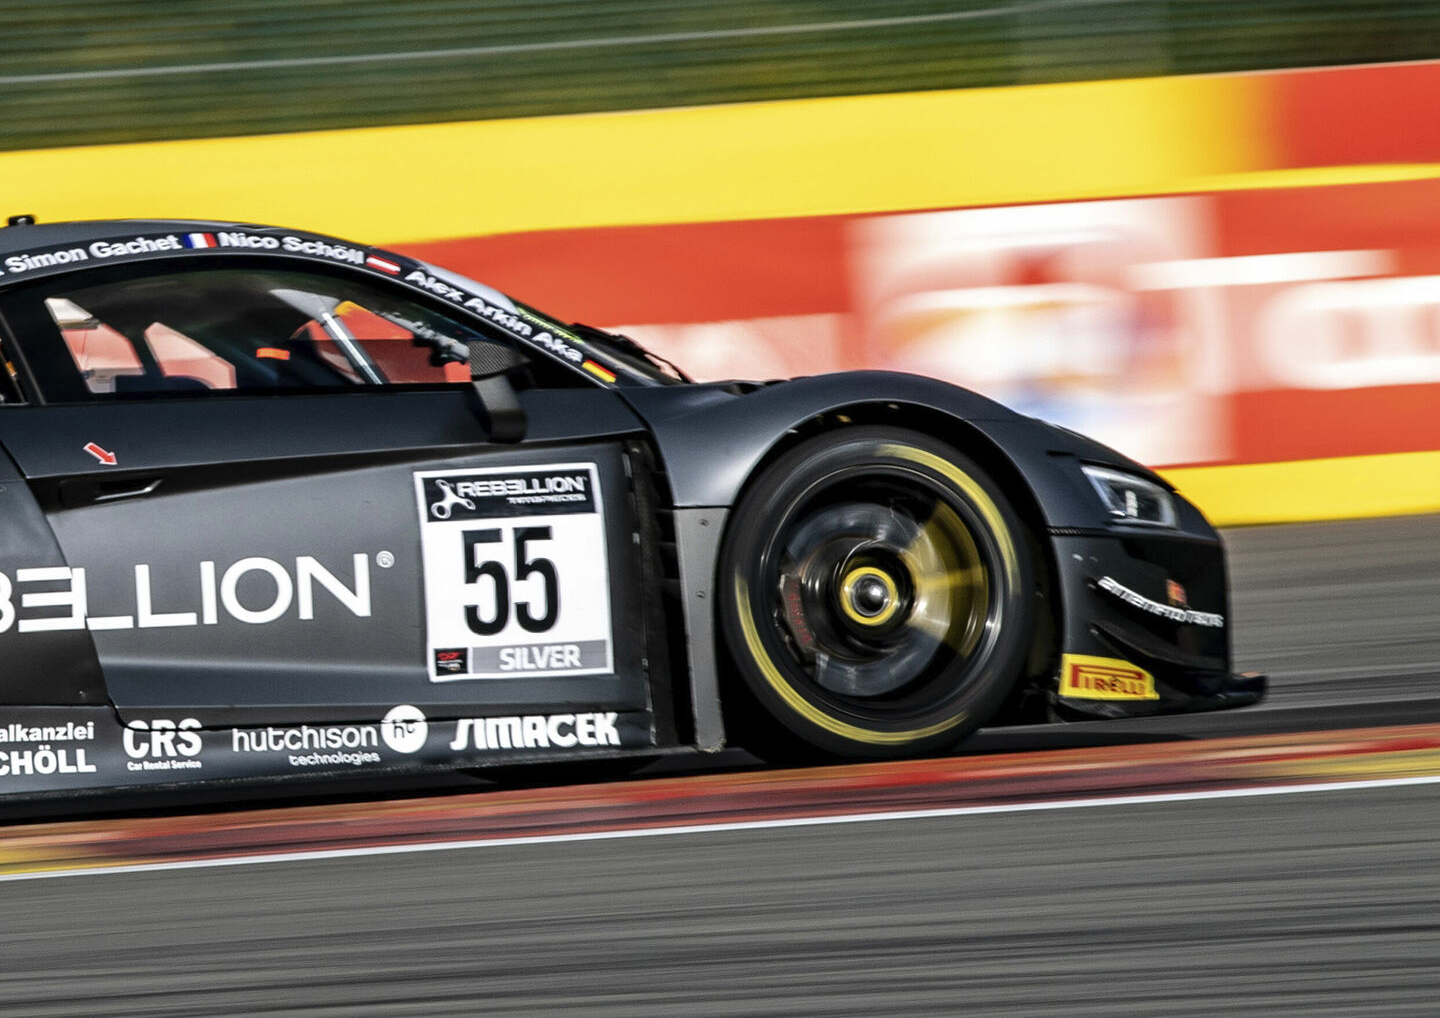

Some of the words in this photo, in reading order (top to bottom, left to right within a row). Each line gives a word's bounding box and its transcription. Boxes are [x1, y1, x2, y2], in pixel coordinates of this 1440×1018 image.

[4, 248, 89, 273] Simon
[89, 234, 183, 259] Gachet
[217, 232, 280, 249] Nico
[281, 236, 365, 265] Schöll
[404, 270, 465, 303] Alex
[464, 298, 534, 337] Arkin
[531, 332, 584, 364] Aka
[455, 476, 586, 498] REBELLION
[461, 525, 559, 636] 55
[498, 645, 583, 670] SILVER
[1069, 663, 1146, 696] PIRELLI
[122, 718, 203, 759] CRS
[231, 725, 379, 752] hutchison
[449, 712, 622, 751] SIMACEK
[127, 761, 143, 772] Car
[171, 759, 202, 770] Service
[288, 751, 381, 766] technologies
